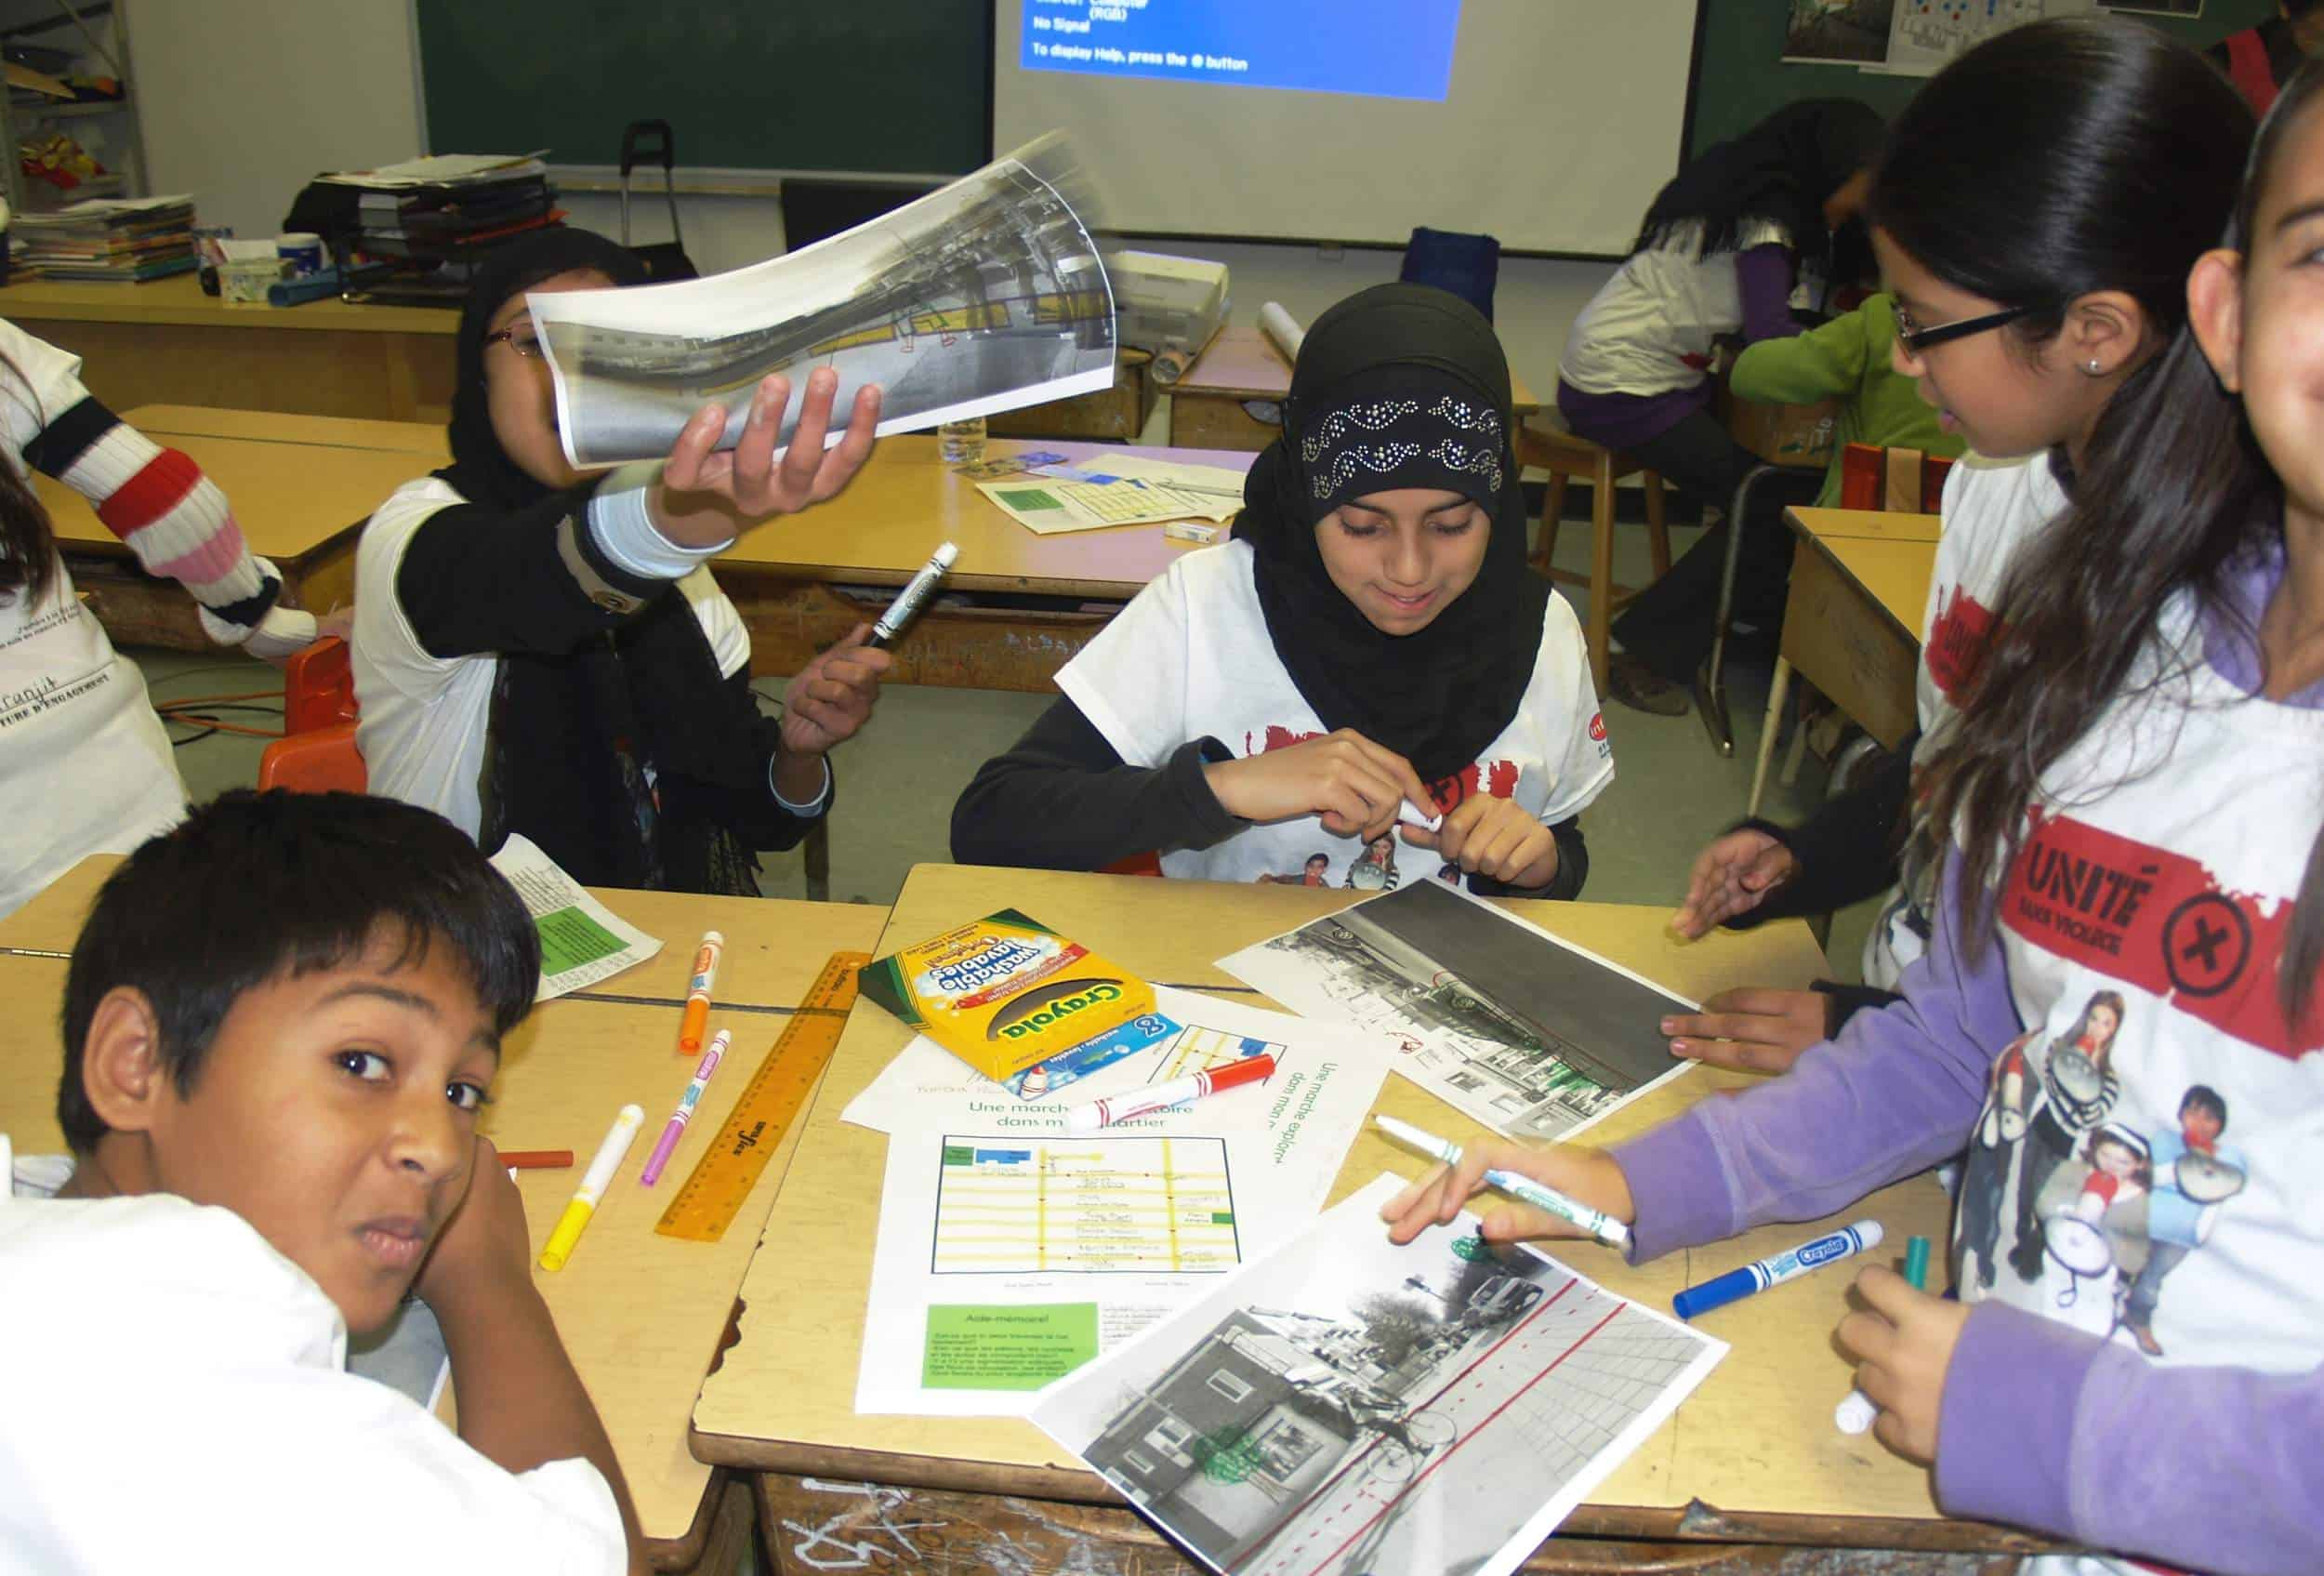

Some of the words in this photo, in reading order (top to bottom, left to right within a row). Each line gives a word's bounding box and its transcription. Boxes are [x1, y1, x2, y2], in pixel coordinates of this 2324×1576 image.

[1033, 16, 1051, 30] No
[1053, 18, 1090, 33] Signal
[1032, 42, 1049, 56] To
[1050, 44, 1093, 61] display
[1128, 51, 1164, 66] press
[1166, 52, 1187, 67] the
[1206, 54, 1248, 72] button
[2027, 841, 2159, 928] UNITÉ
[930, 939, 1023, 984] lavables
[938, 944, 1041, 991] washable
[1001, 984, 1122, 1040] Crayola
[1133, 1016, 1167, 1038] 8
[1315, 1062, 1340, 1082] Une
[969, 1101, 1006, 1114] Une
[1010, 1100, 1071, 1114] march
[1293, 1082, 1322, 1120] marche
[997, 1117, 1040, 1128] dans
[1103, 1117, 1168, 1129] uartier
[1800, 1239, 1845, 1263] Crayola
